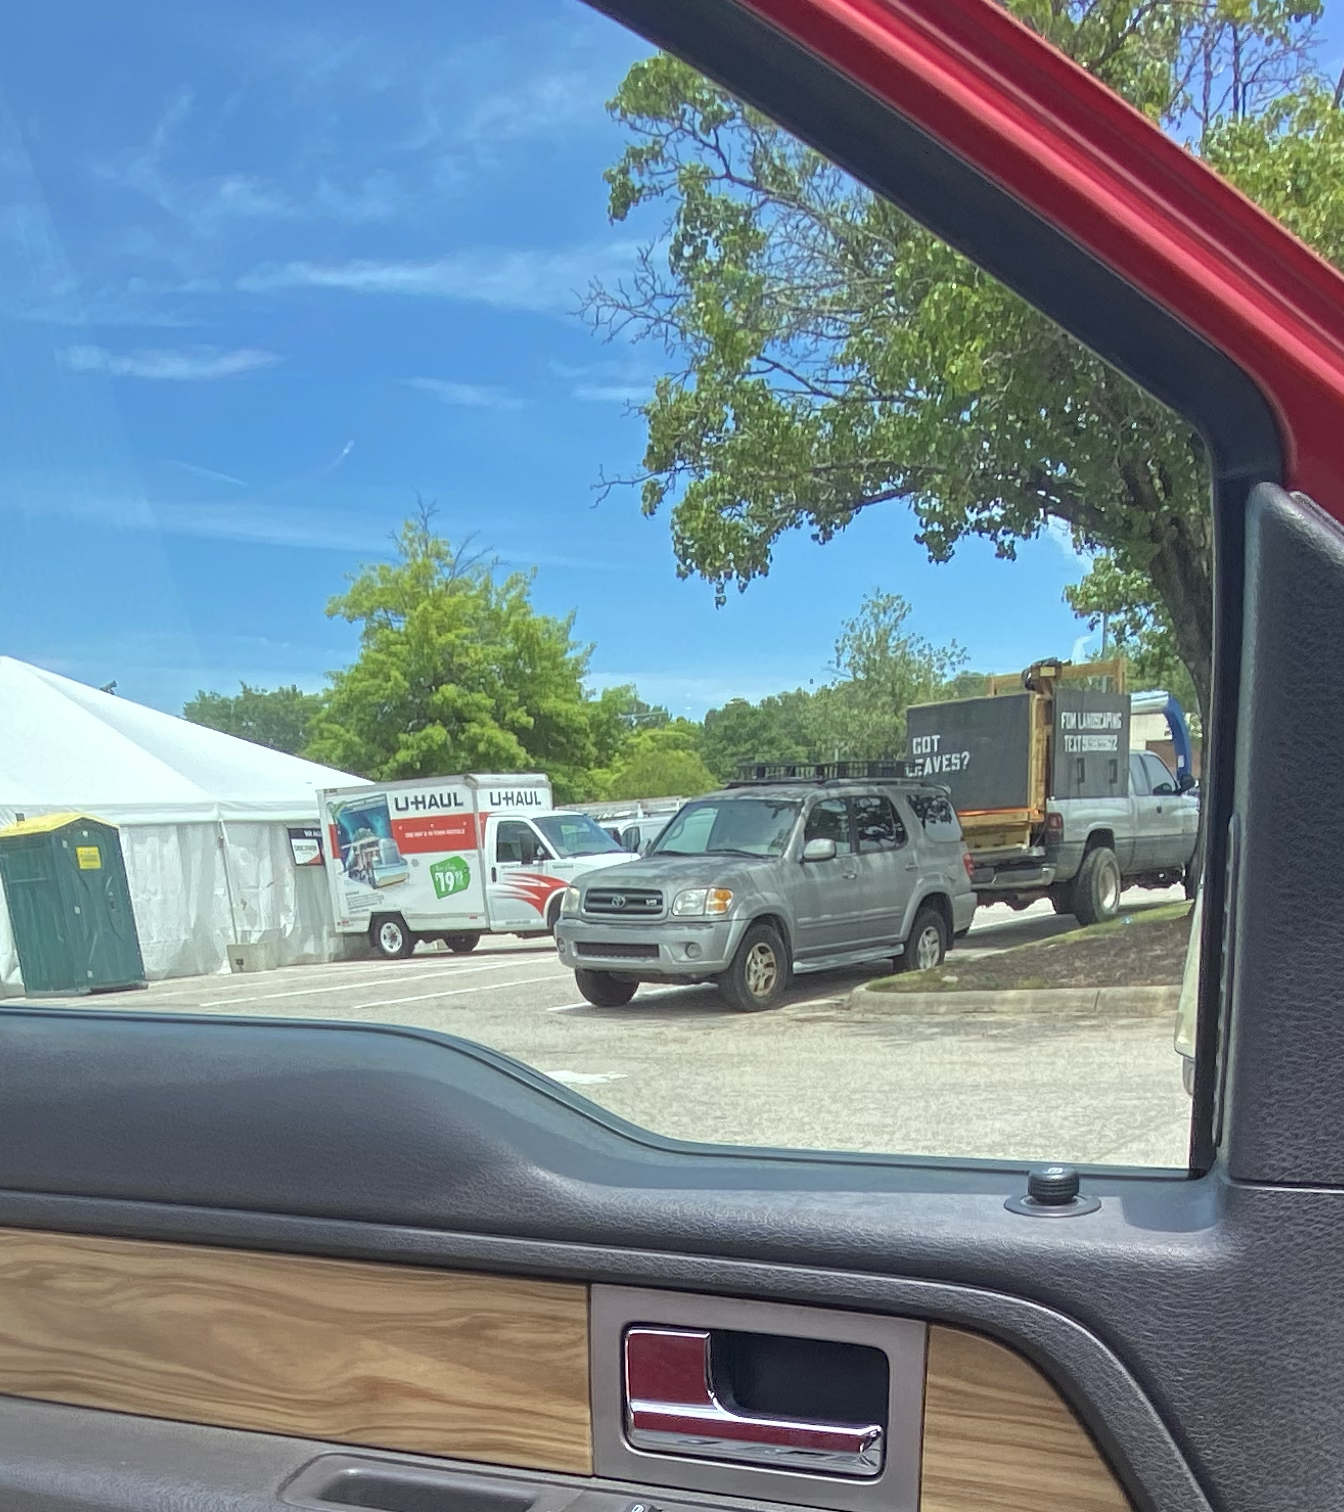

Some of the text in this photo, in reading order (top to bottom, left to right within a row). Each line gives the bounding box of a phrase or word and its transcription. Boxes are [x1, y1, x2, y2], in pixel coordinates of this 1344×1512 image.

[912, 735, 941, 754] GOT
[394, 792, 464, 812] U-HAUL
[490, 791, 542, 806] U-HAUL
